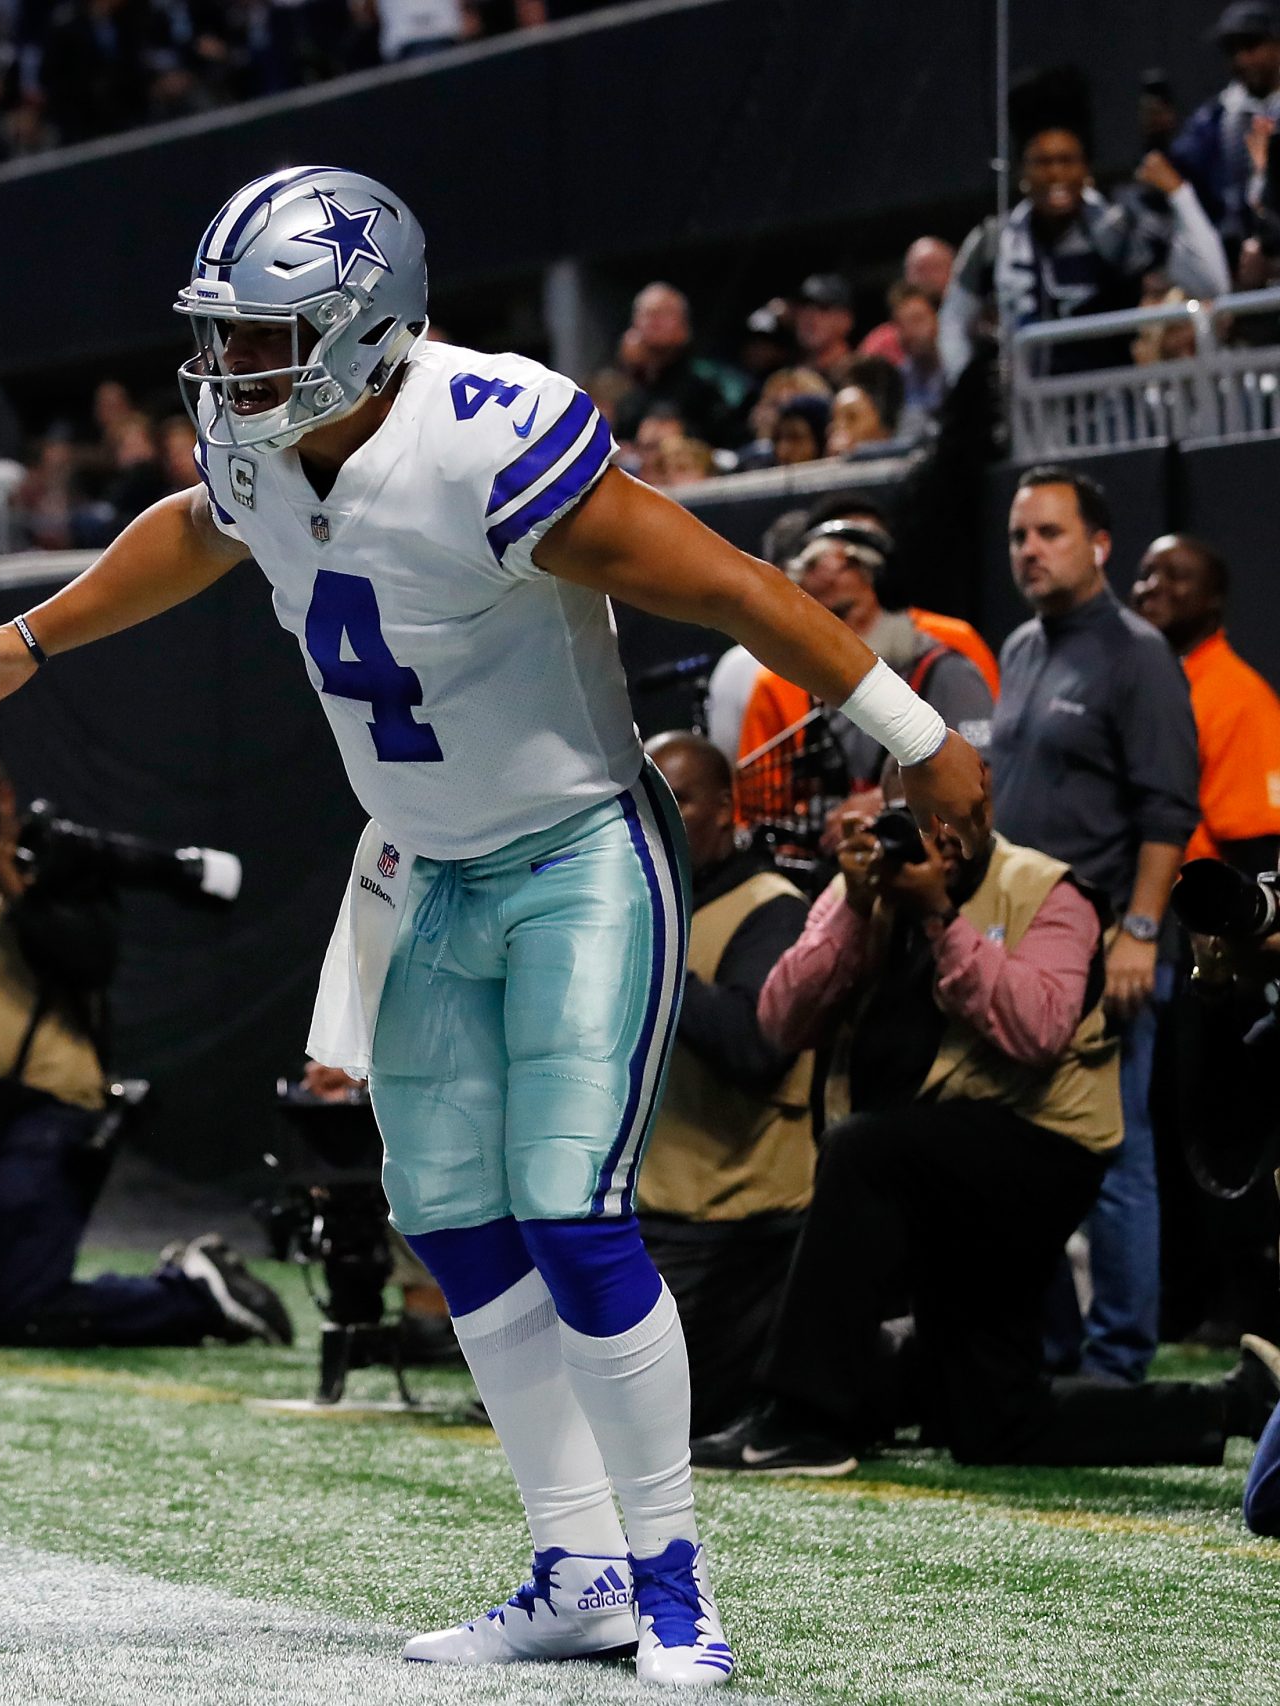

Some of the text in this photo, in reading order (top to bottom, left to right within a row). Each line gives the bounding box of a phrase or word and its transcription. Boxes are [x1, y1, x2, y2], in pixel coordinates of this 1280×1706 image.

[449, 372, 527, 421] 4
[305, 569, 444, 762] 4
[360, 875, 394, 908] Wilson
[577, 1590, 630, 1610] adida
